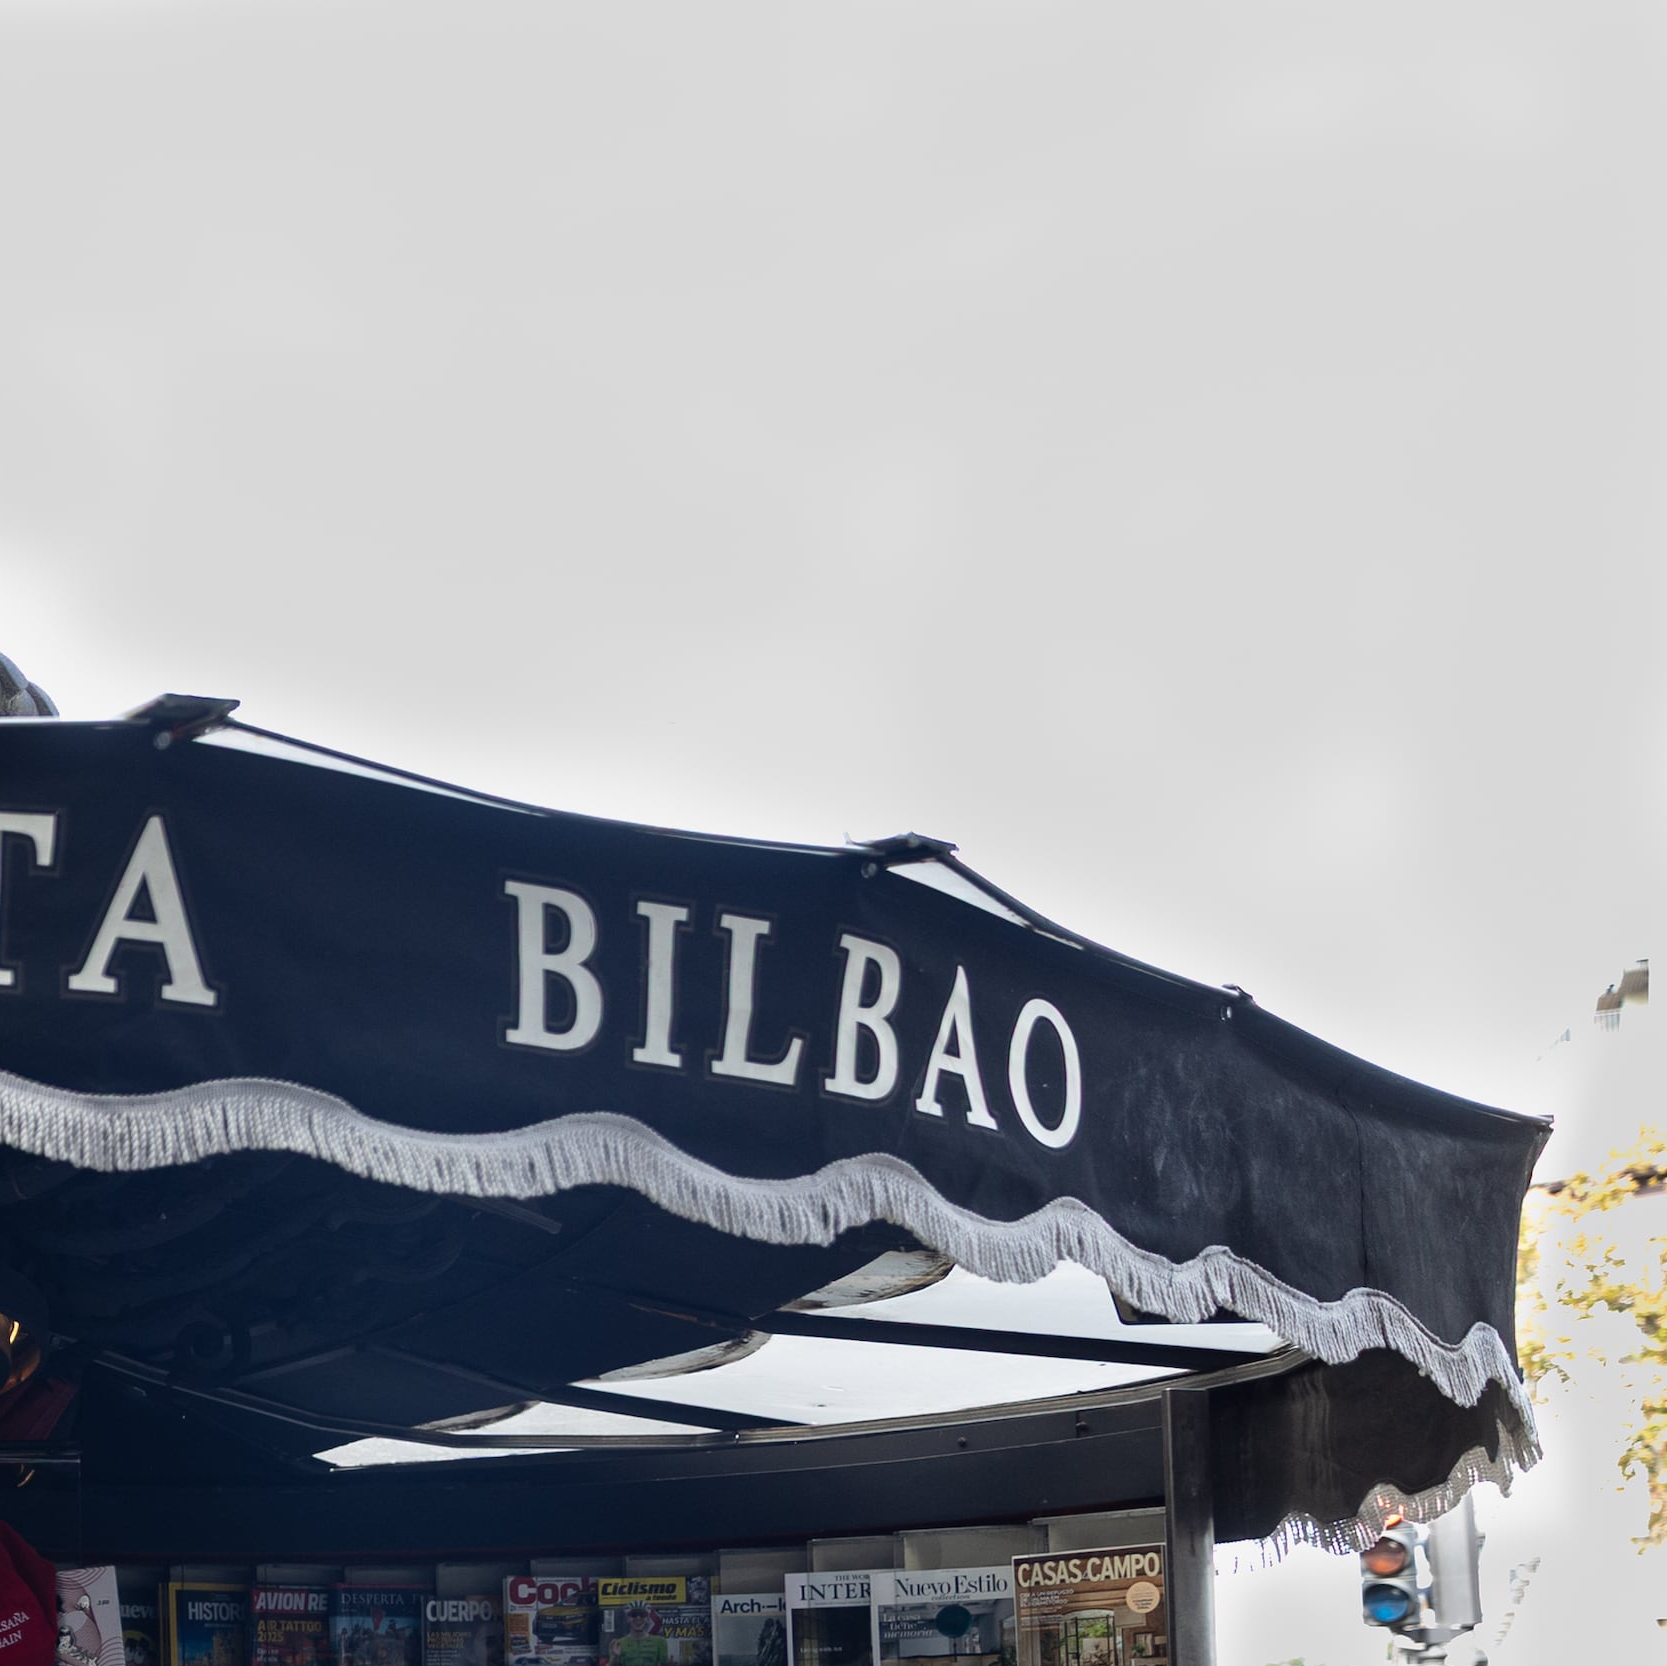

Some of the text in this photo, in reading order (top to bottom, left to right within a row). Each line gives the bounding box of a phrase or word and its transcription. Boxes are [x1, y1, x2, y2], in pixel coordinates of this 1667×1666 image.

[503, 879, 1082, 1149] BILBAO
[1017, 1552, 1160, 1587] CASAS CAMPO
[601, 1582, 675, 1596] Ciclismo
[896, 1574, 1007, 1598] Nuevo Estilo
[256, 1592, 306, 1611] AVION
[341, 1594, 403, 1605] DESPERTA
